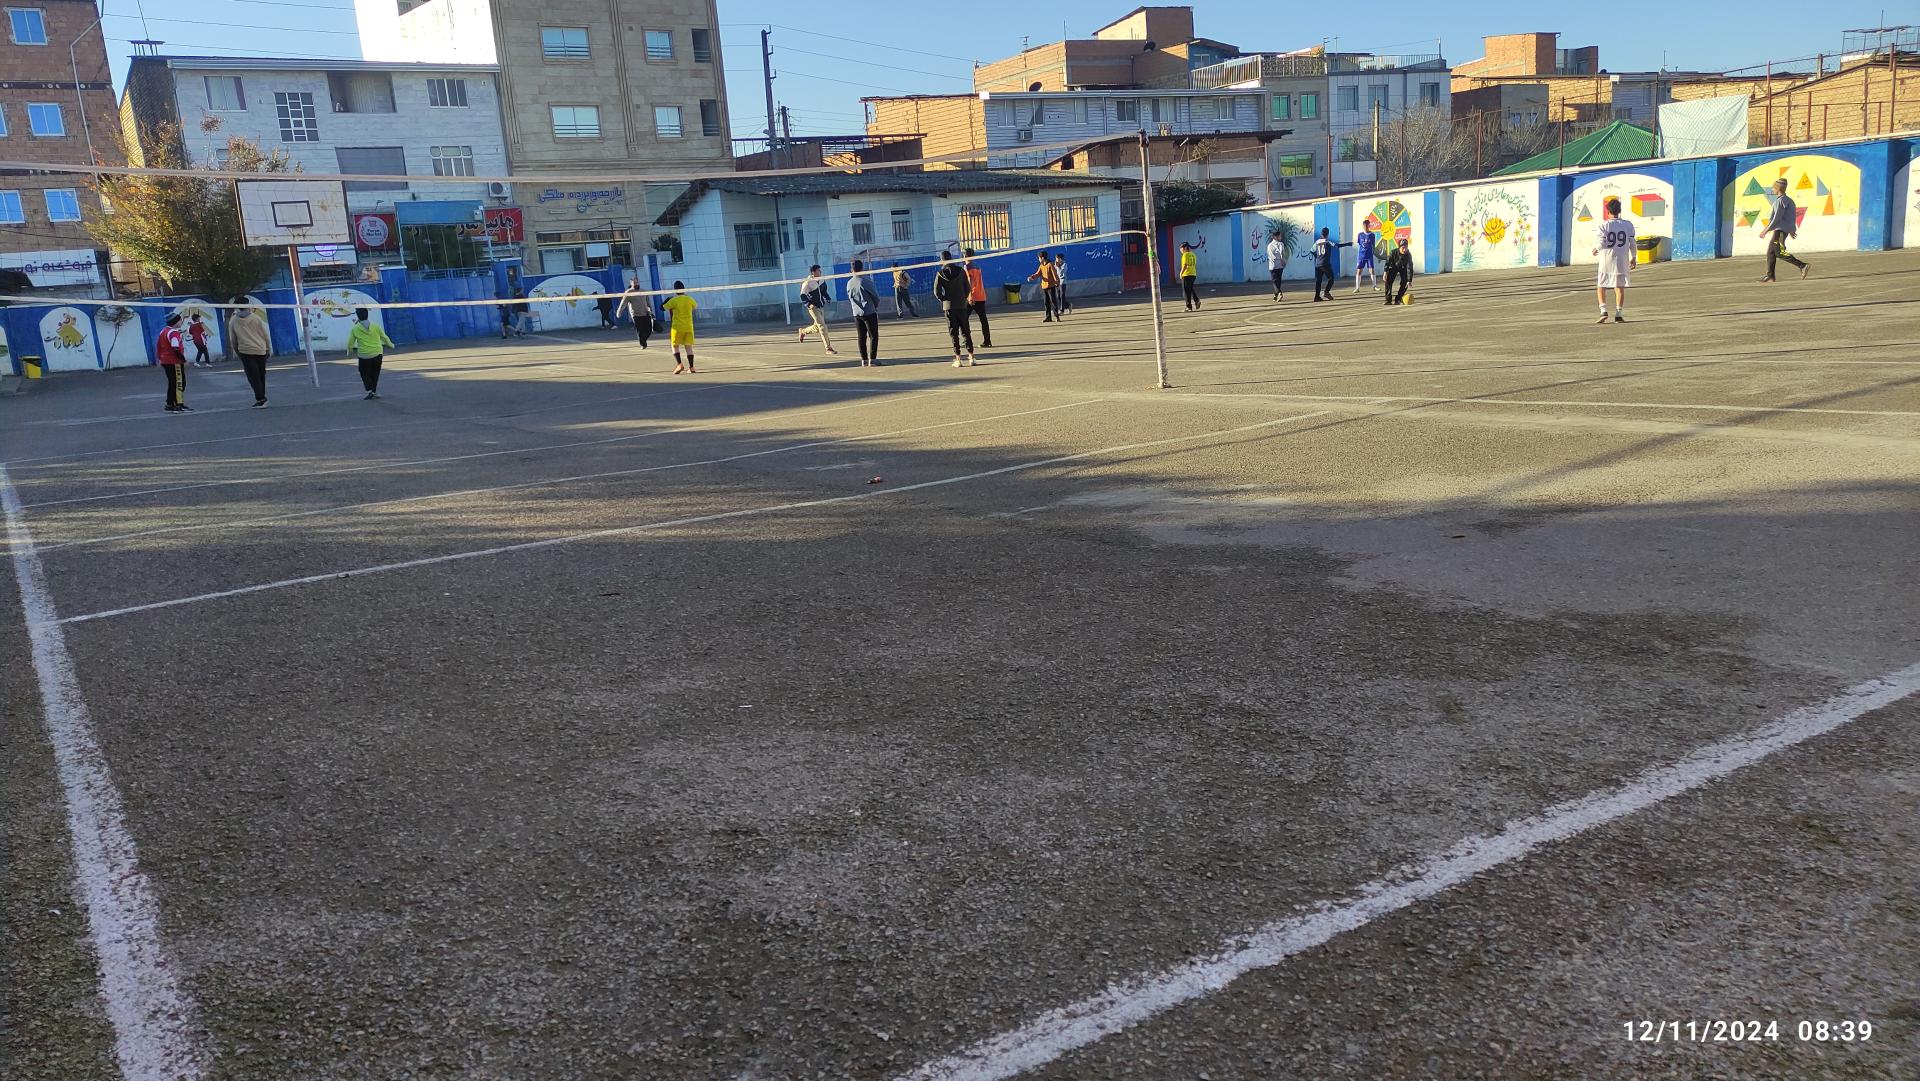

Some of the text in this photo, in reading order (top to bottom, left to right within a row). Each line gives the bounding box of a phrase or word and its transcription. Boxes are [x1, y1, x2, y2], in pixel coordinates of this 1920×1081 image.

[536, 186, 565, 204] ملکی
[567, 190, 591, 203] پرده
[600, 186, 622, 202] پارچه
[1607, 231, 1627, 248] 99
[1317, 244, 1326, 256] 16
[42, 255, 93, 273] فروشگاه
